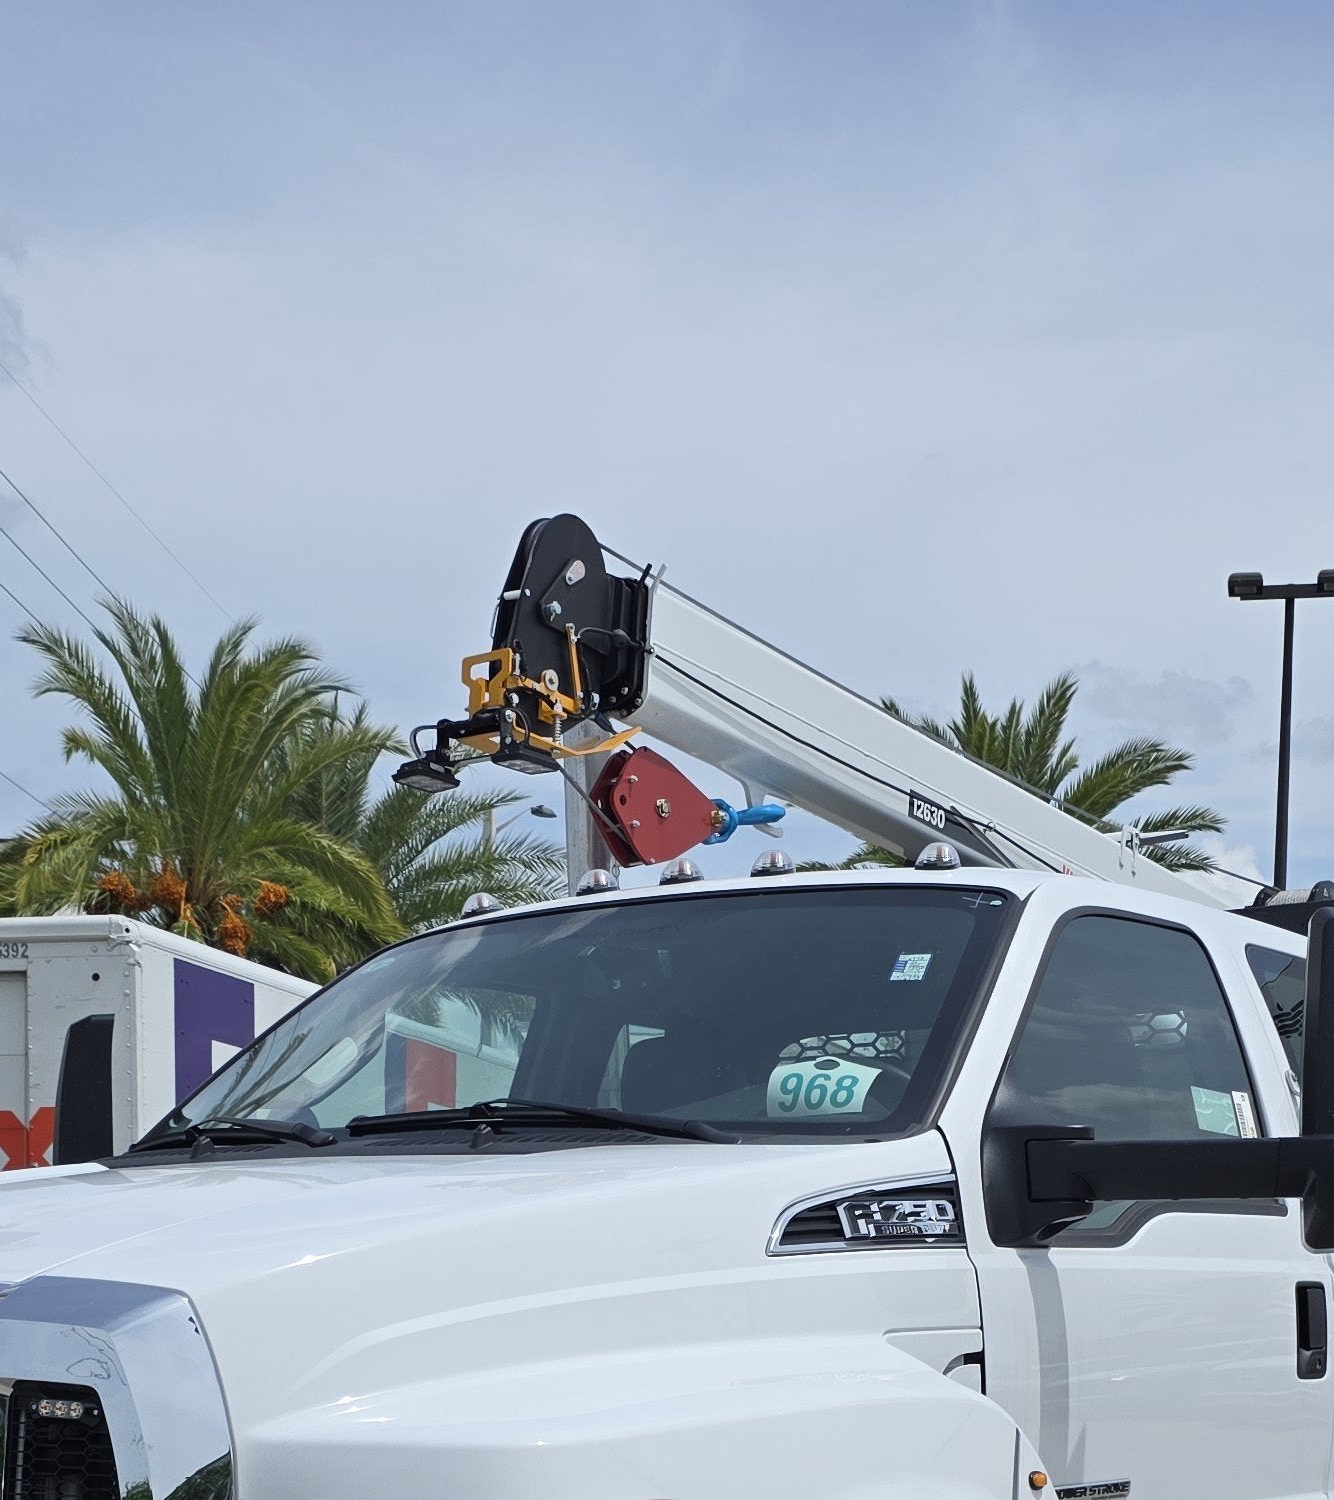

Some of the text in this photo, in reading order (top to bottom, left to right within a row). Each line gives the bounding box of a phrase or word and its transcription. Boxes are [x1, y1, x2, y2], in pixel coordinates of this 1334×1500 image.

[912, 798, 946, 829] 12630
[778, 1072, 860, 1113] 968
[1056, 1487, 1086, 1500] OWER
